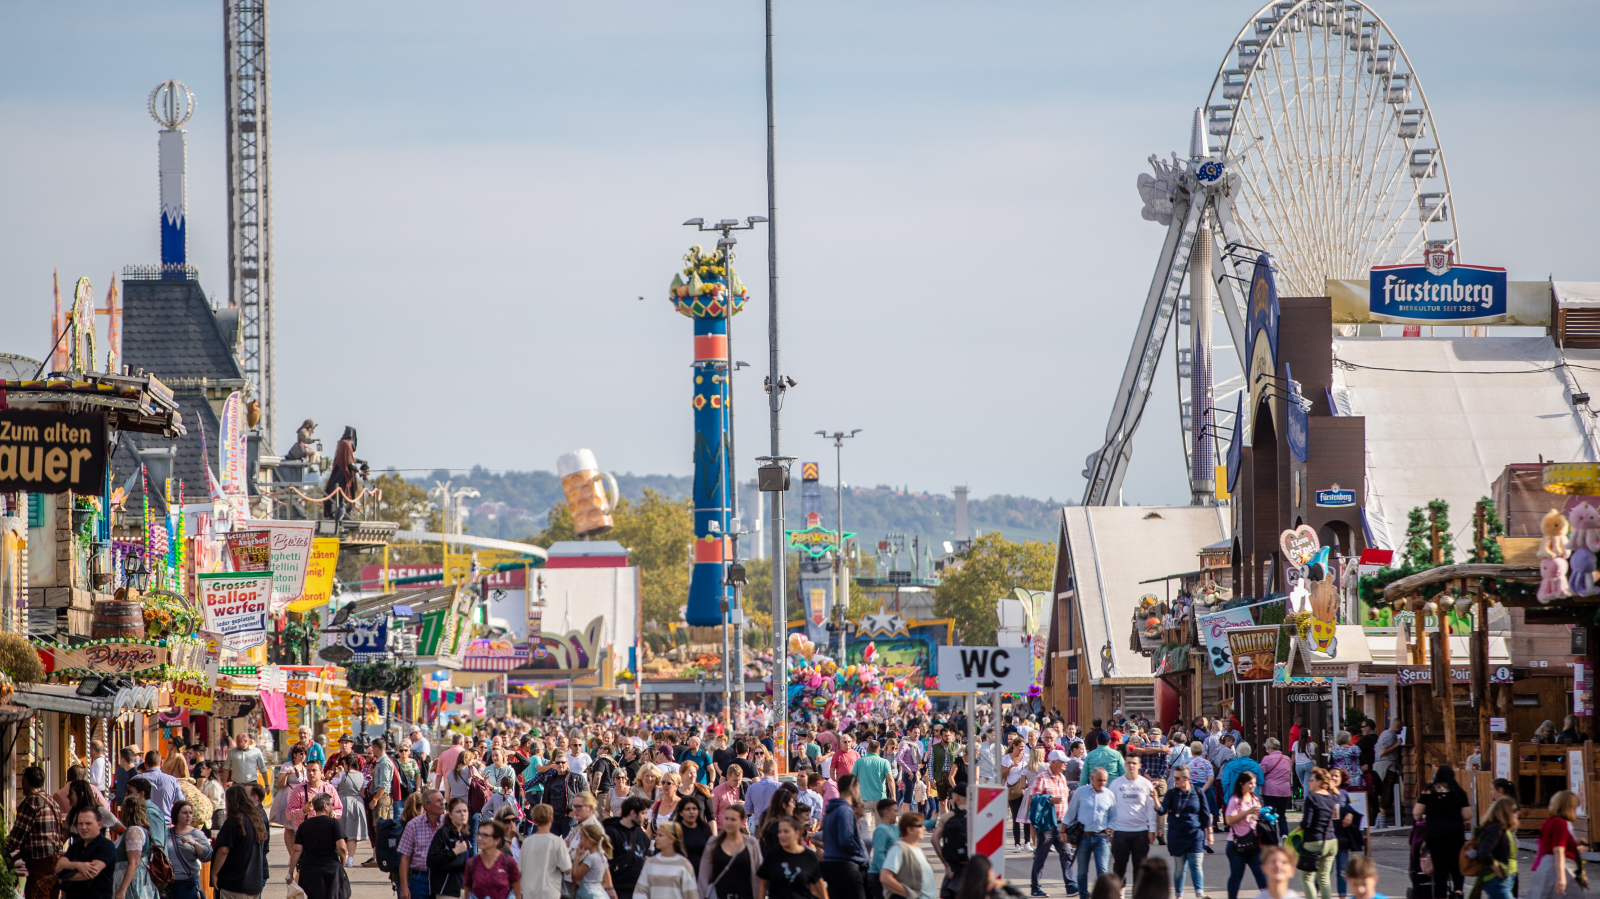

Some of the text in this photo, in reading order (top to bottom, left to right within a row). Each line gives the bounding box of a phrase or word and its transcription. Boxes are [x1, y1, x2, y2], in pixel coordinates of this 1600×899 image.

[1382, 274, 1493, 309] Fürstenberg
[1398, 304, 1441, 312] BIERKULTUR
[0, 420, 91, 444] Zum alten
[1320, 492, 1352, 502] Fürstenberg
[1294, 537, 1310, 546] Love
[270, 552, 301, 562] aghetti
[273, 574, 297, 582] atoni
[212, 580, 258, 592] Grosses
[207, 590, 262, 606] Ballon-
[213, 601, 265, 617] werfen
[1230, 631, 1276, 655] Churros
[960, 649, 1010, 678] WC
[1402, 668, 1432, 680] Servi
